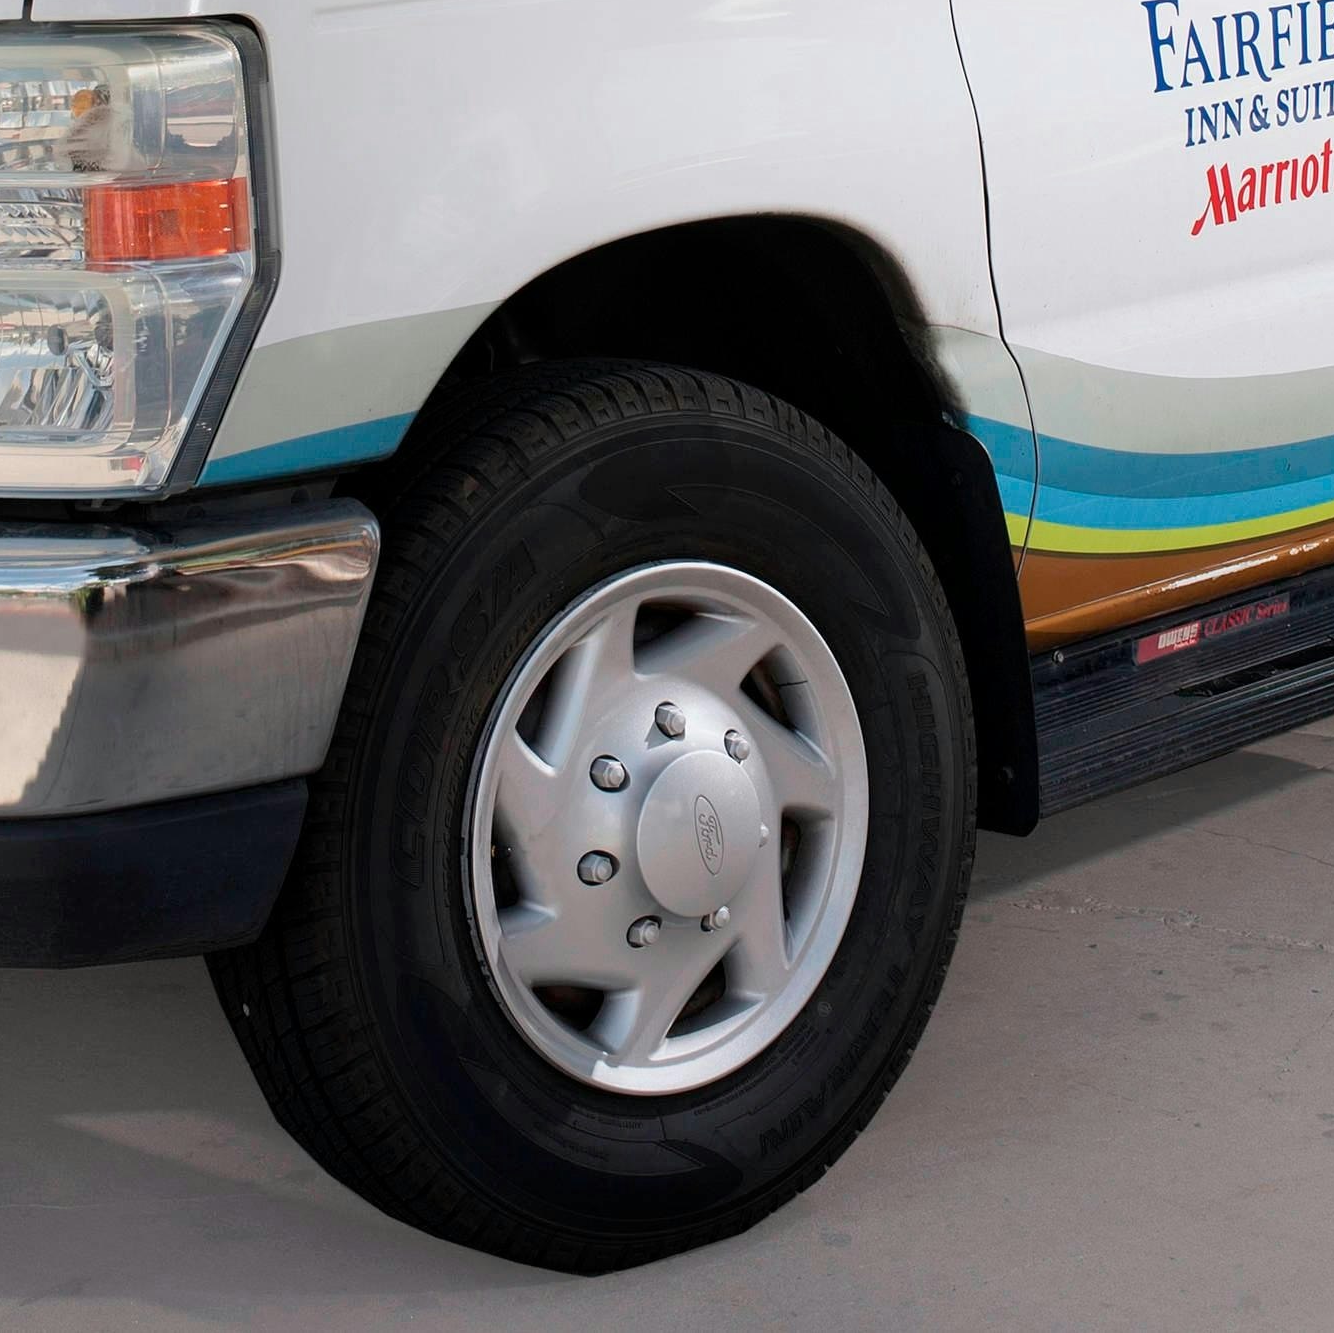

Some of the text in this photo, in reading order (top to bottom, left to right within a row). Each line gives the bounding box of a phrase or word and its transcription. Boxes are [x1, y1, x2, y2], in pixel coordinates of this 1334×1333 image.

[1204, 607, 1252, 638] CLASSIC
[1256, 598, 1288, 622] Series
[697, 812, 721, 861] Ford
